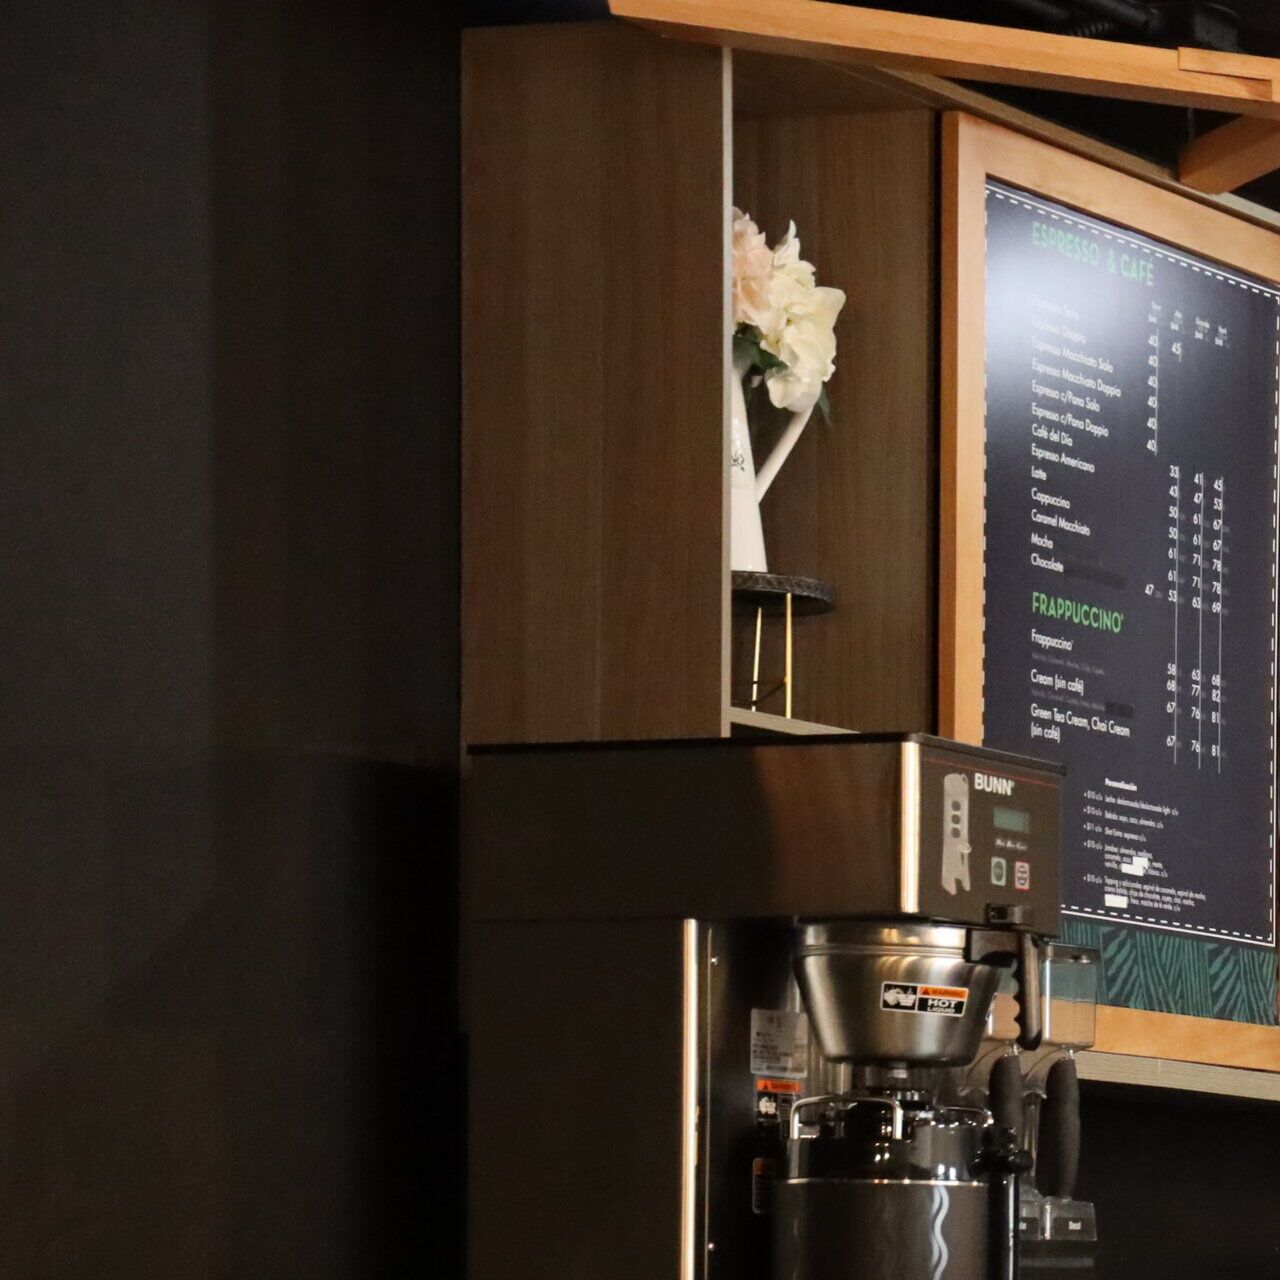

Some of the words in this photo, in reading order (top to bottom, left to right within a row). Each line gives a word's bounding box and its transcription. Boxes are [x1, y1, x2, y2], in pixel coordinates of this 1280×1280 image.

[1032, 221, 1099, 266] ESPRESSO
[1106, 250, 1116, 273] &
[1120, 255, 1154, 286] CAFÉ
[1032, 335, 1062, 356] Espresso
[1062, 347, 1097, 368] Macchiato
[1098, 358, 1114, 373] Solo
[1148, 335, 1157, 347] 40
[1171, 342, 1182, 355] 45
[1148, 355, 1157, 367] 40
[1032, 357, 1061, 378] Espresso
[1062, 369, 1097, 389] Macchiato
[1097, 378, 1121, 398] Doppio
[1147, 375, 1157, 387] 40
[1032, 379, 1060, 401] Espresso
[1086, 397, 1100, 413] Solo
[1147, 396, 1157, 408] 40
[1032, 401, 1060, 423] Espresso
[1086, 418, 1109, 438] Doppio
[1147, 417, 1157, 430] 40
[1031, 423, 1048, 440] Café
[1049, 430, 1060, 443] del
[1060, 431, 1073, 447] Día
[1146, 439, 1157, 452] 40
[1031, 443, 1060, 464] Espresso
[1060, 452, 1095, 473] Americano
[1031, 465, 1047, 481] Latte
[1169, 464, 1179, 479] 33
[1194, 473, 1203, 486] 41
[1213, 479, 1222, 492] 45
[1031, 487, 1070, 509] Cappuccino
[1169, 485, 1178, 498] 43
[1193, 493, 1202, 504] 47
[1213, 499, 1222, 511] 53
[1031, 509, 1058, 528] Caramel
[1058, 516, 1091, 536] Macchiato
[1168, 506, 1178, 519] 50
[1193, 513, 1201, 525] 61
[1212, 518, 1222, 531] 67
[1031, 533, 1053, 549] Mocha
[1168, 527, 1178, 540] 50
[1192, 533, 1201, 546] 61
[1212, 540, 1222, 551] 67
[1030, 552, 1064, 573] Chocolate
[1168, 547, 1177, 560] 61
[1192, 553, 1201, 566] 71
[1212, 559, 1222, 572] 78
[1168, 570, 1177, 582] 61
[1192, 576, 1201, 589] 71
[1212, 582, 1222, 594] 78
[1144, 584, 1154, 595] 47
[1168, 589, 1177, 602] 53
[1192, 596, 1201, 609] 63
[1212, 601, 1221, 613] 69
[1031, 669, 1053, 687] Cream
[1055, 673, 1067, 690] (sin
[1067, 678, 1084, 696] café)
[1167, 663, 1177, 676] 58
[1191, 668, 1201, 681] 63
[1211, 674, 1221, 686] 68
[1167, 679, 1176, 692] 68
[1191, 684, 1200, 697] 77
[1211, 689, 1221, 702] 82
[1030, 703, 1052, 720] Green
[1053, 707, 1065, 722] Tea
[1066, 711, 1090, 731] Cream,
[1091, 716, 1107, 732] Chai
[1108, 720, 1130, 737] Cream
[1166, 701, 1176, 714] 67
[1191, 706, 1200, 720] 76
[1211, 712, 1221, 724] 81
[1030, 721, 1043, 738] (sin
[1043, 725, 1060, 743] café)
[1166, 735, 1176, 747] 67
[1191, 740, 1200, 753] 76
[1211, 745, 1221, 757] 81
[927, 998, 958, 1009] HOT
